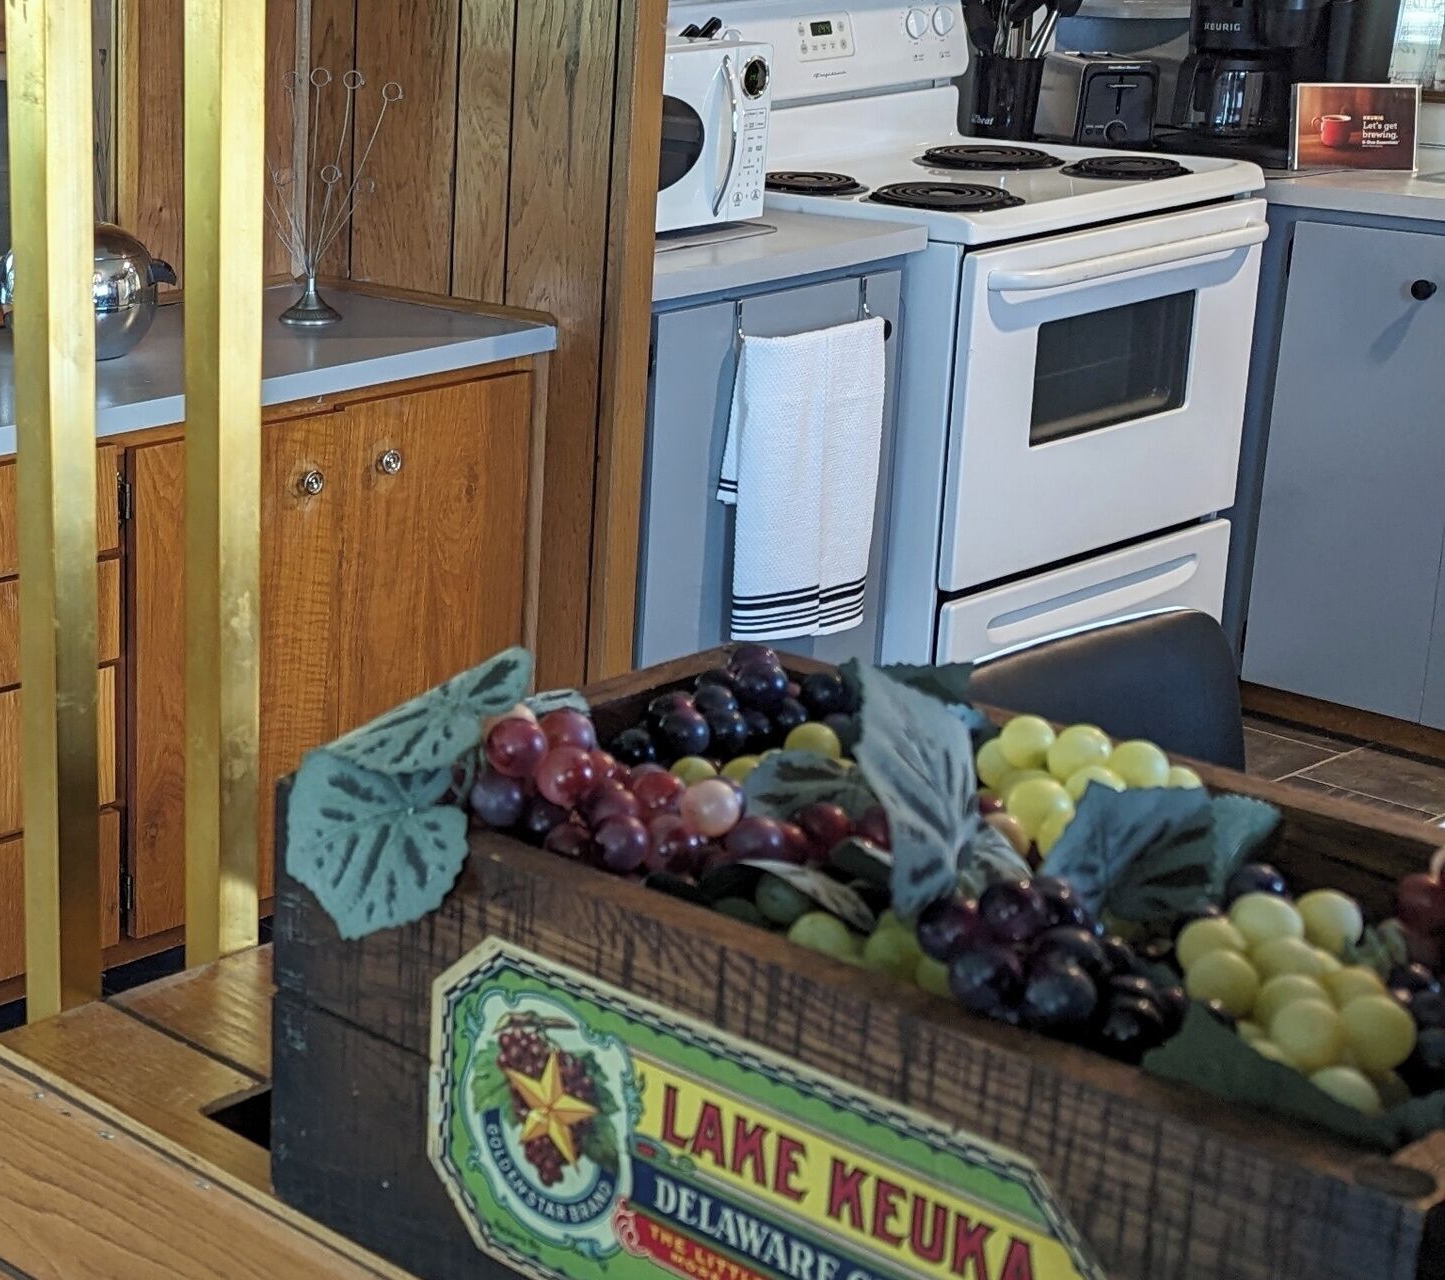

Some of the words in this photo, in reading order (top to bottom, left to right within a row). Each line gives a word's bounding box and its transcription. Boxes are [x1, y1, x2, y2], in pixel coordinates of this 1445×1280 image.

[1203, 22, 1242, 32] KEURIG
[1362, 121, 1383, 130] Let's
[1383, 122, 1398, 131] get
[1362, 130, 1399, 140] brewing.
[660, 1083, 810, 1204] LAKE
[485, 1122, 528, 1195] GOLDEN
[524, 1191, 568, 1221] STAR
[567, 1180, 613, 1223] BRAND
[649, 1223, 687, 1256] THE
